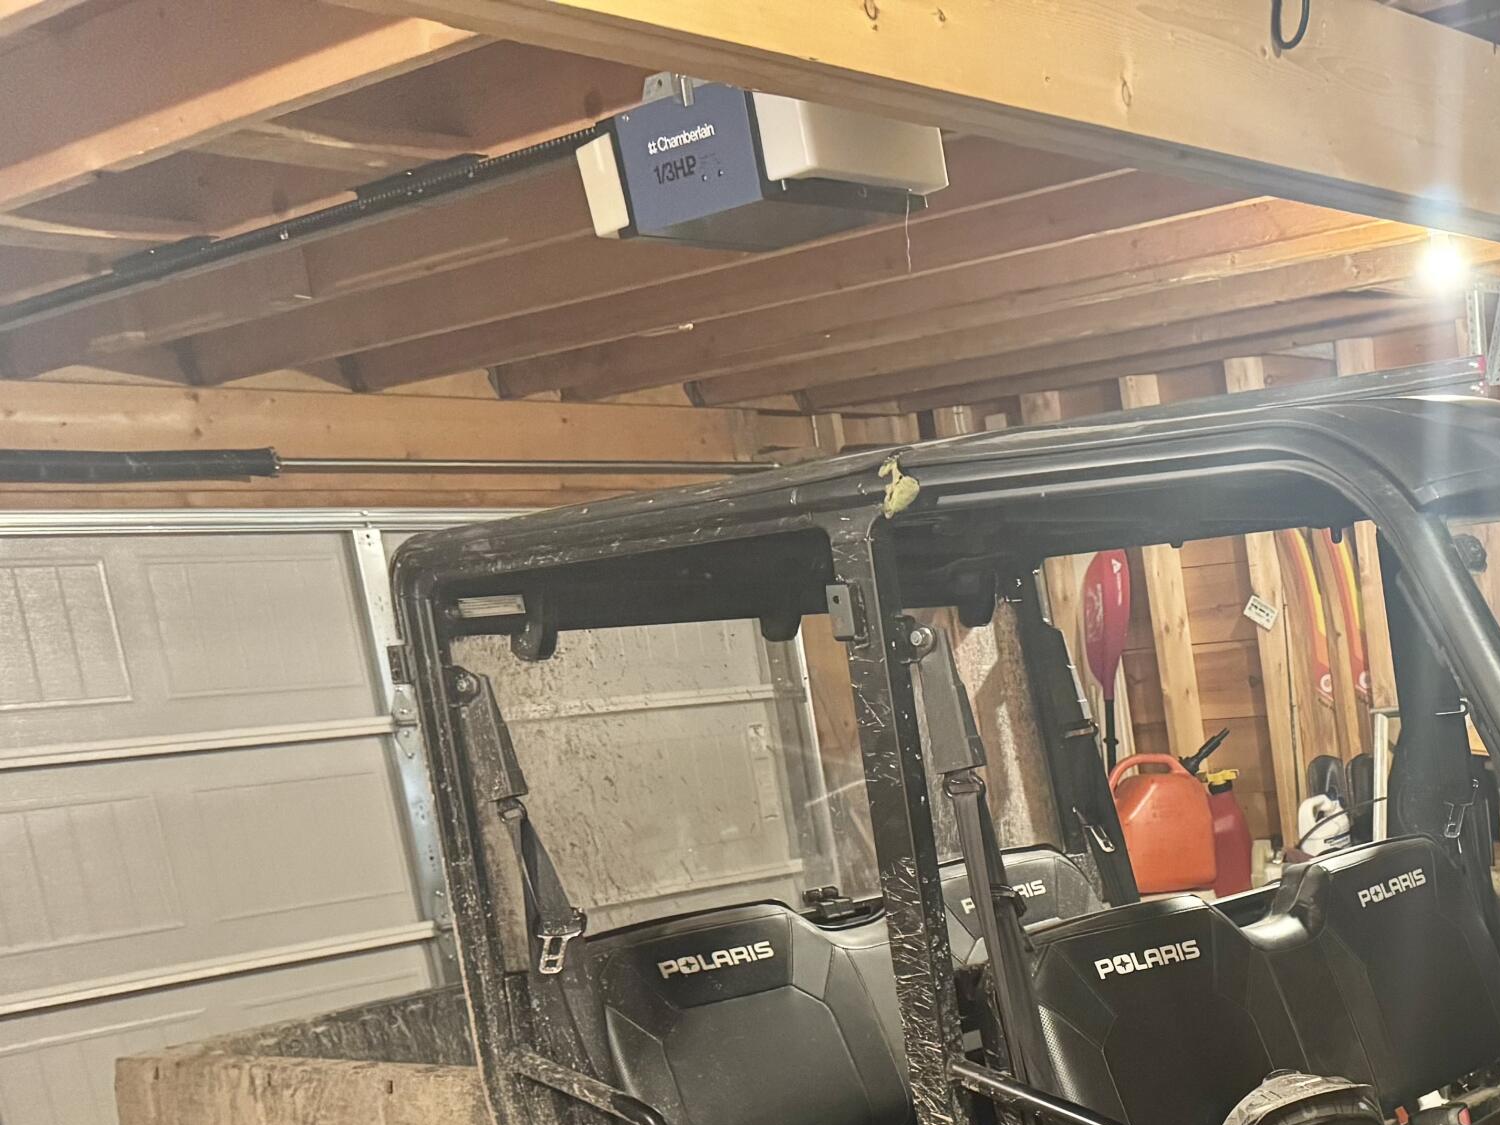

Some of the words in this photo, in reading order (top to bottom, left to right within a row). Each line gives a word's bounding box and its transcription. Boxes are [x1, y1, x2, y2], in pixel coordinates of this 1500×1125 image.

[657, 123, 716, 152] Chamberlain
[961, 880, 1047, 915] PRIS
[1357, 868, 1426, 908] POLARIS
[658, 941, 774, 979] POLARIS
[1094, 939, 1201, 980] POLARIS
